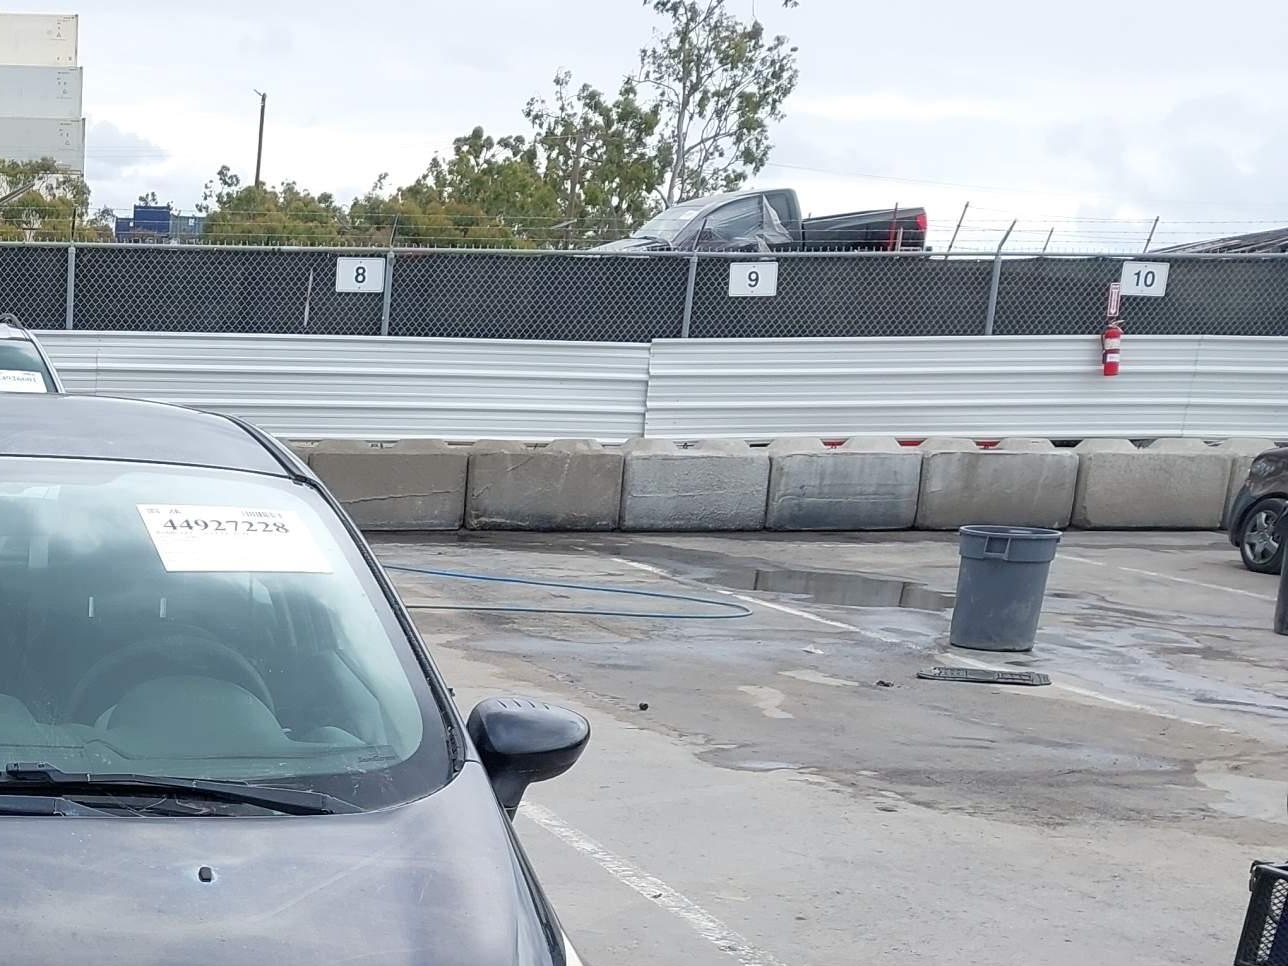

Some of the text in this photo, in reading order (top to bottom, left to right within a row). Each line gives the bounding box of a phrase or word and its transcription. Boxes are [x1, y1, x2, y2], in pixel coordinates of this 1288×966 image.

[354, 266, 366, 284] 8
[748, 270, 759, 288] 9
[1133, 270, 1156, 288] 10
[162, 518, 290, 534] 44927228
